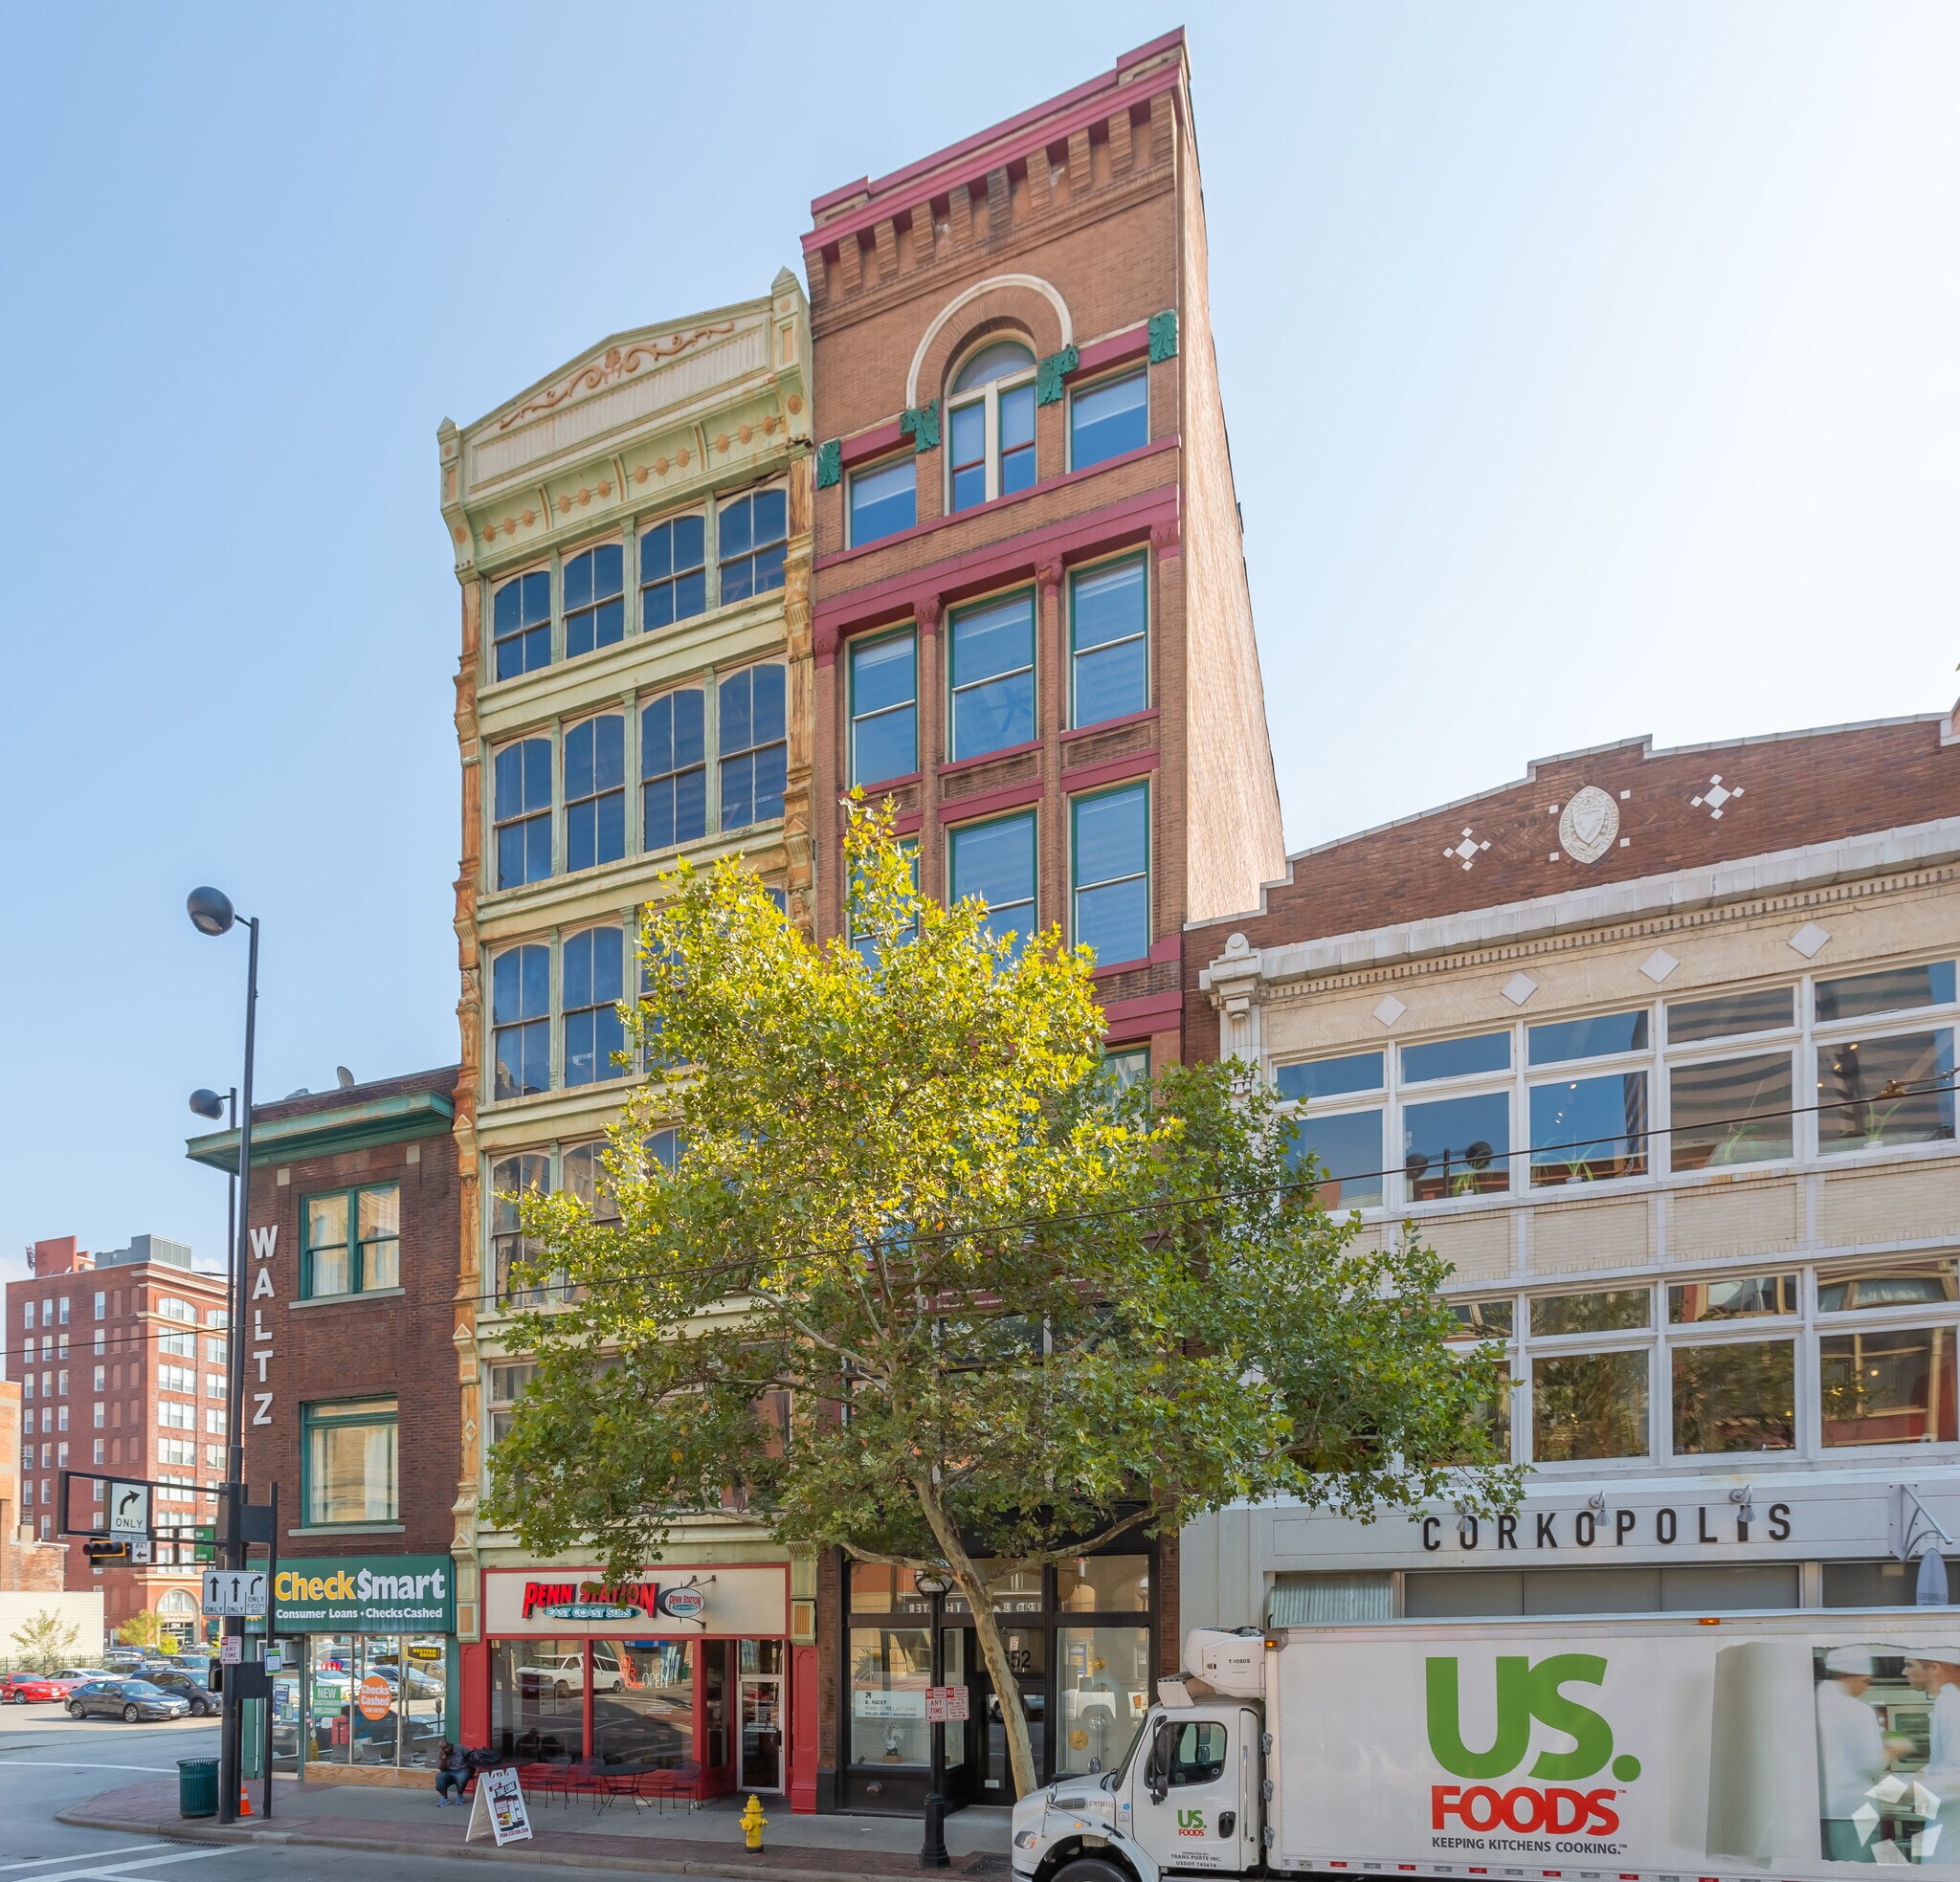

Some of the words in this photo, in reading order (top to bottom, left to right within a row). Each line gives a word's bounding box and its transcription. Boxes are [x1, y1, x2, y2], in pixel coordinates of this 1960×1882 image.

[249, 1225, 278, 1426] WALTZ
[115, 1517, 144, 1529] ONLY
[1422, 1503, 1792, 1551] CORKOPOLIS
[523, 1583, 576, 1619] PENN
[276, 1608, 327, 1619] Consumer
[329, 1607, 359, 1619] Loans
[366, 1607, 403, 1619] Checks
[404, 1607, 443, 1619] Cashed
[546, 1607, 570, 1617] EAST
[572, 1607, 606, 1618] COAST
[606, 1607, 632, 1618] SUBS
[642, 1672, 668, 1689] OPEN
[318, 1688, 336, 1699] NEW
[361, 1684, 390, 1695] Checks
[361, 1695, 390, 1707] Cashed
[1432, 1785, 1620, 1837] FOODS
[1432, 1837, 1485, 1849] KEEPING
[1488, 1839, 1552, 1852] KITCHENS
[1555, 1842, 1621, 1855] COOKING.
